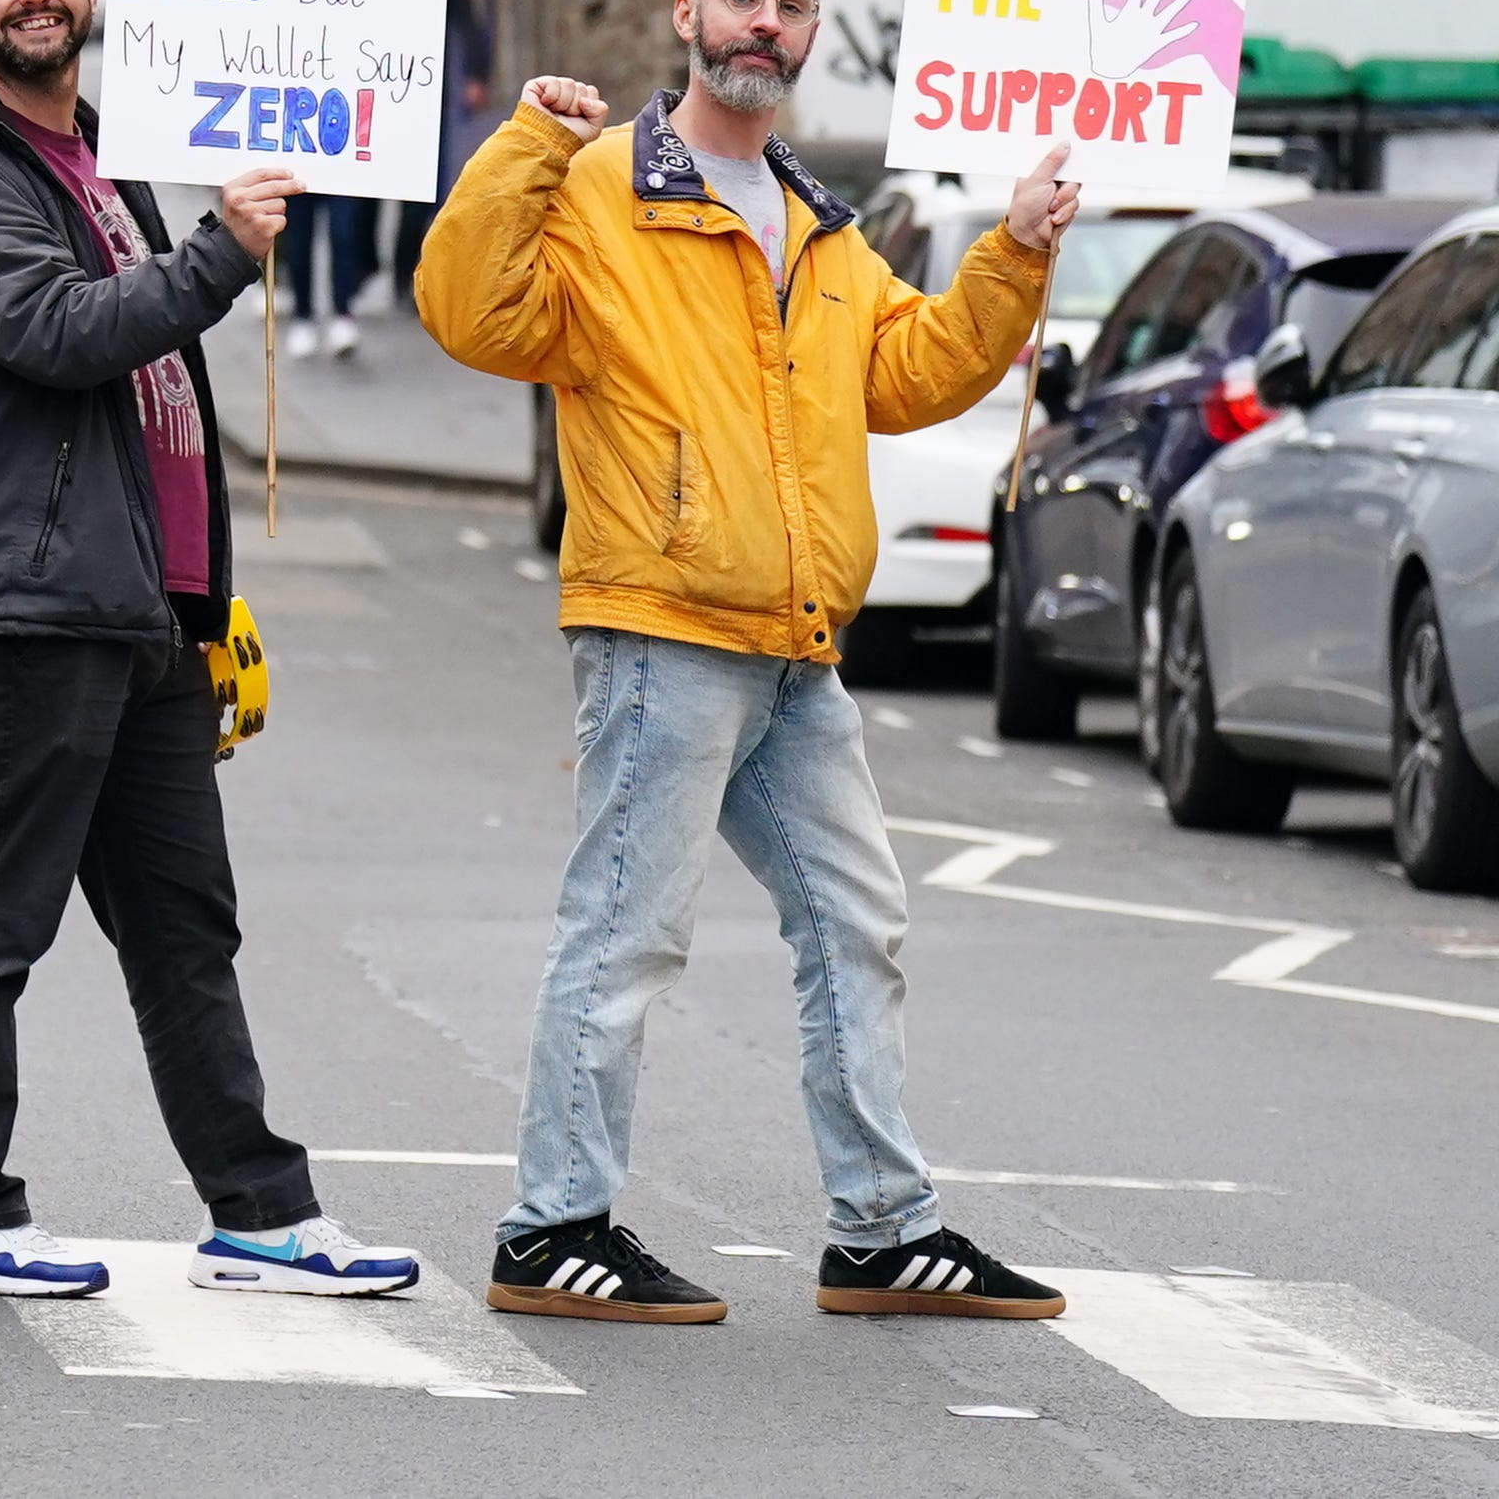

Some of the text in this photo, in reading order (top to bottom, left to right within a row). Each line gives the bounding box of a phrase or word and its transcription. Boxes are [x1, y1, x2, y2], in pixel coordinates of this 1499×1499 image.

[122, 20, 436, 103] My Wallet Says
[916, 61, 1202, 144] SUPPORT
[189, 81, 374, 161] ZERO!
